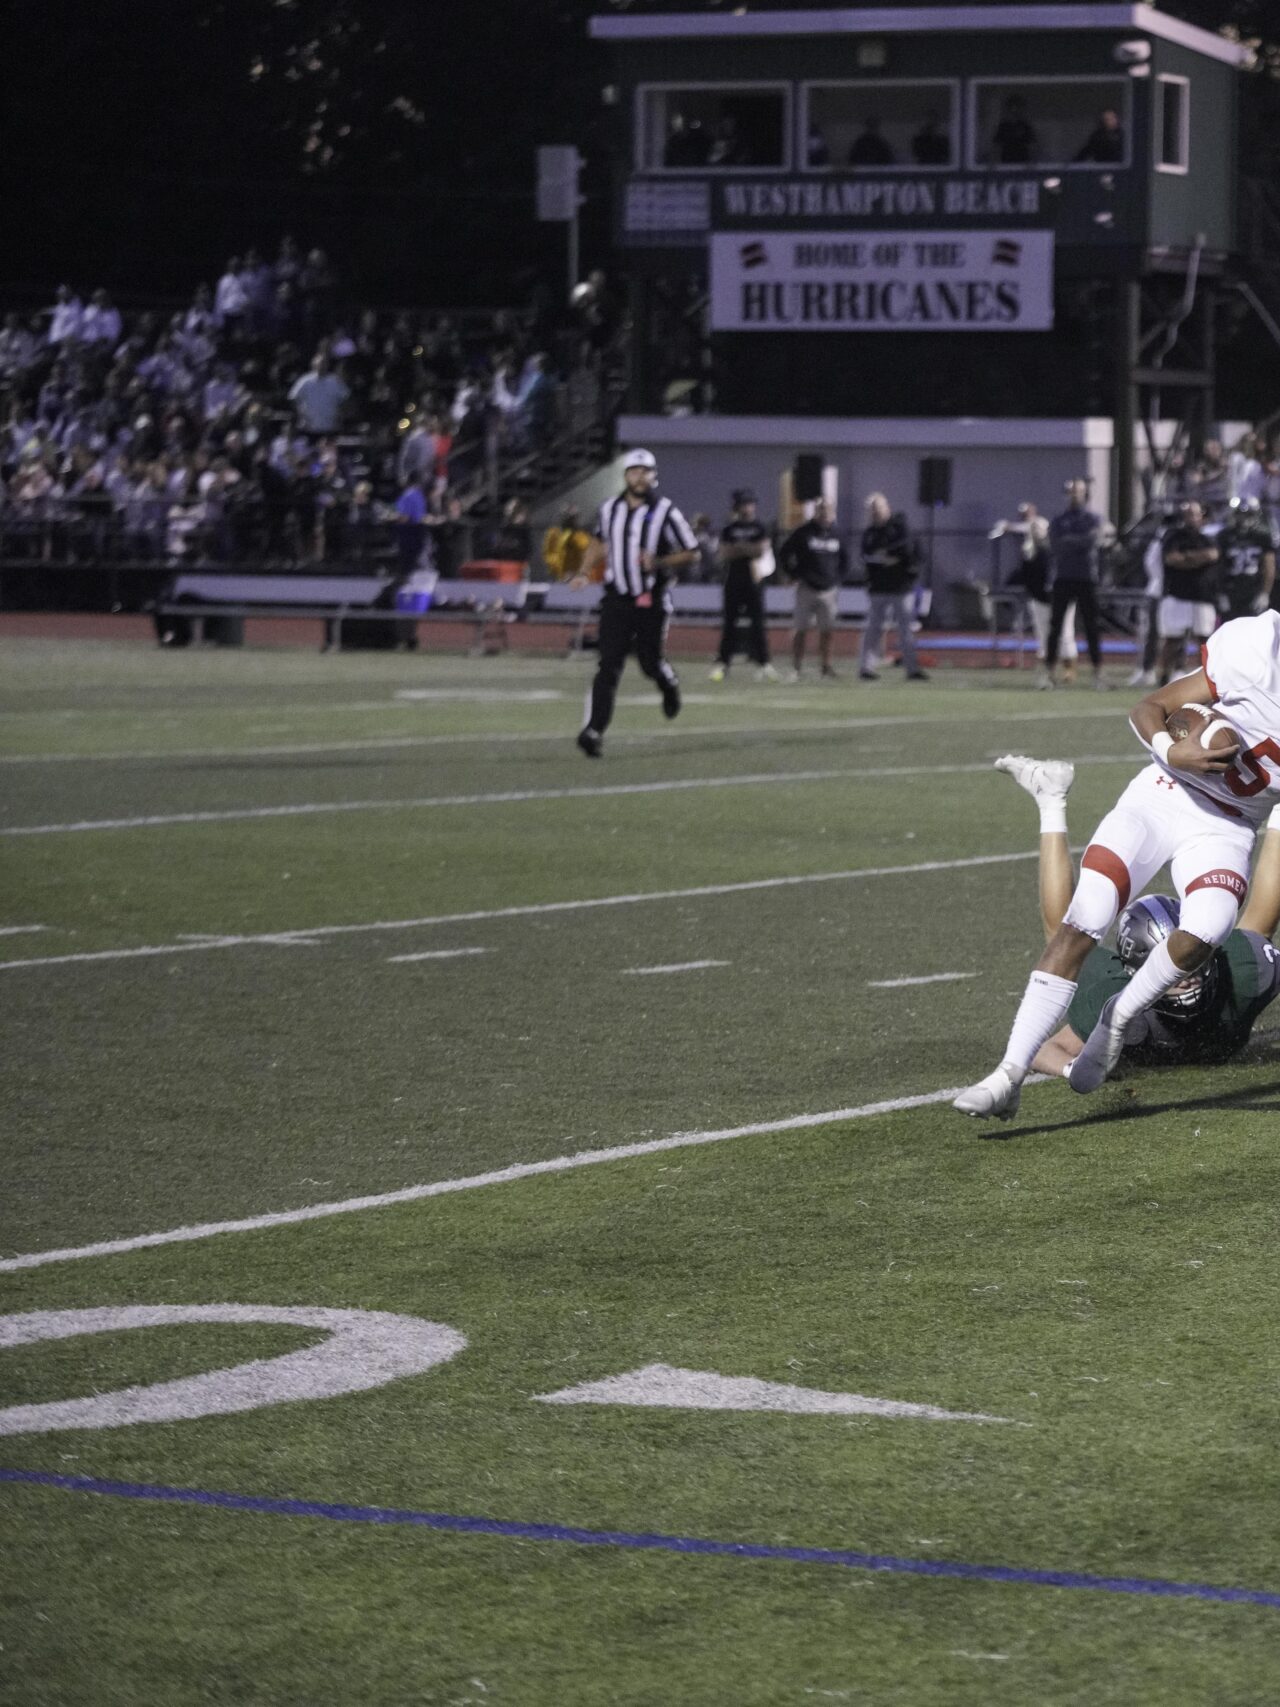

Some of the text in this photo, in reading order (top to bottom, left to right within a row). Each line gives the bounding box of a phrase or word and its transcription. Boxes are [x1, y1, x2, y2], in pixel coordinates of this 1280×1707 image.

[724, 182, 934, 215] WESTHAMPTON
[944, 181, 1040, 214] BEACH
[794, 242, 966, 269] HOME OF THE
[741, 280, 1021, 323] HURRICANES
